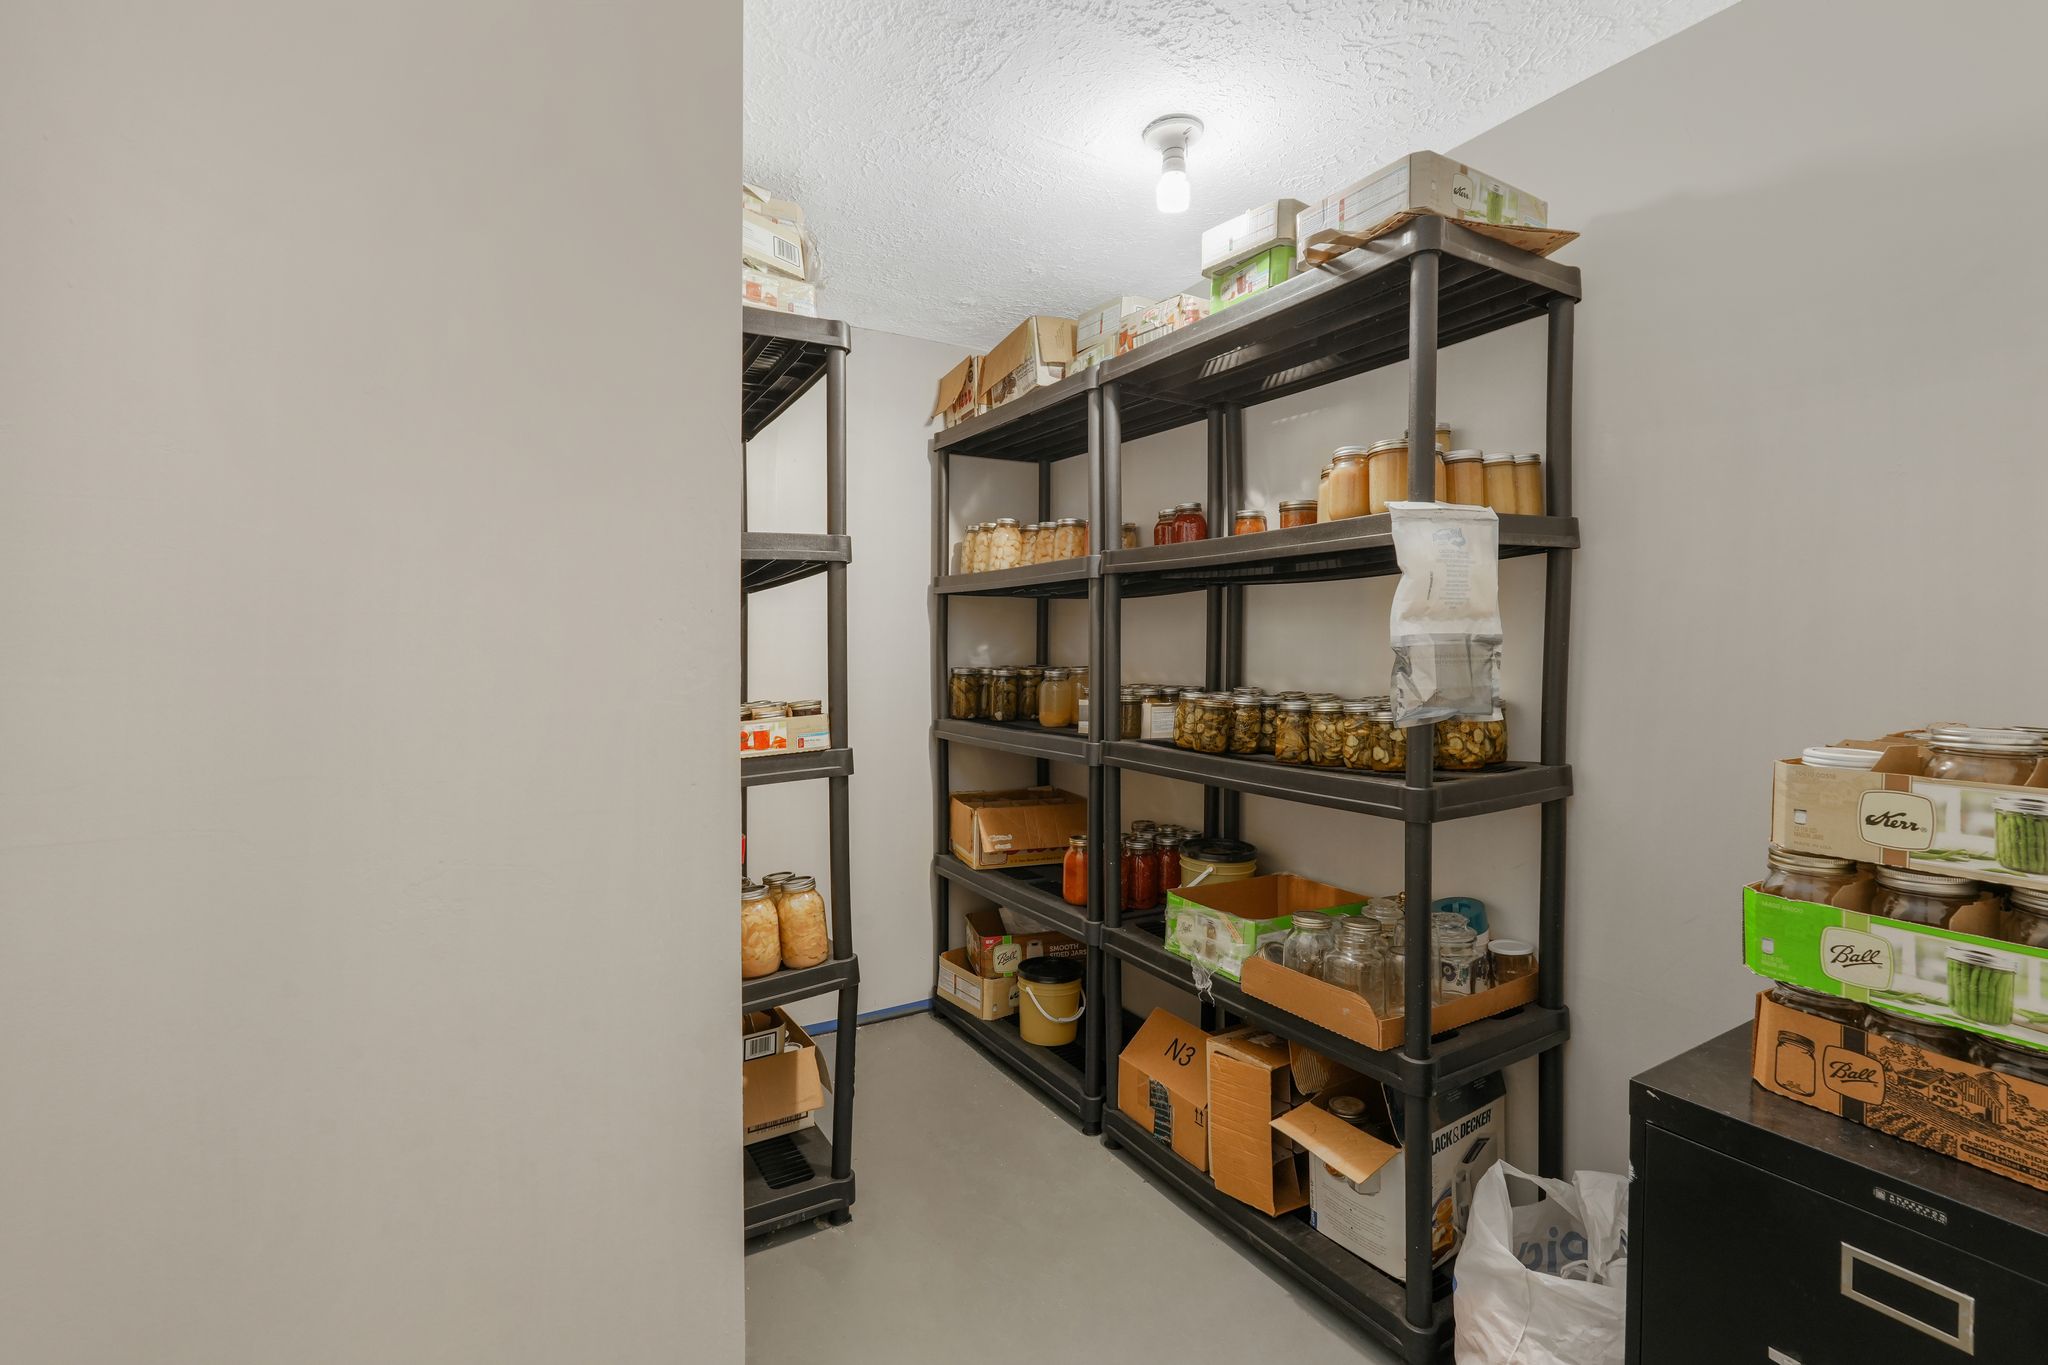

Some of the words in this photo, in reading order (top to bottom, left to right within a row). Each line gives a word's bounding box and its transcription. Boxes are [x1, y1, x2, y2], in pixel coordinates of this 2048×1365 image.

[1865, 811, 1919, 831] Kerr
[1049, 943, 1079, 952] SMOOTH
[1071, 949, 1087, 957] JARS
[1830, 944, 1883, 968] Ball
[997, 950, 1018, 966] Ball
[1164, 1038, 1196, 1067] N3
[1829, 1060, 1878, 1085] Ball
[1431, 1108, 1492, 1155] LACK&DECKER
[1961, 1137, 1996, 1154] Regular
[1999, 1150, 2029, 1165] Mouth
[1974, 1136, 2021, 1156] SMOOTH
[1995, 1156, 2021, 1170] Label
